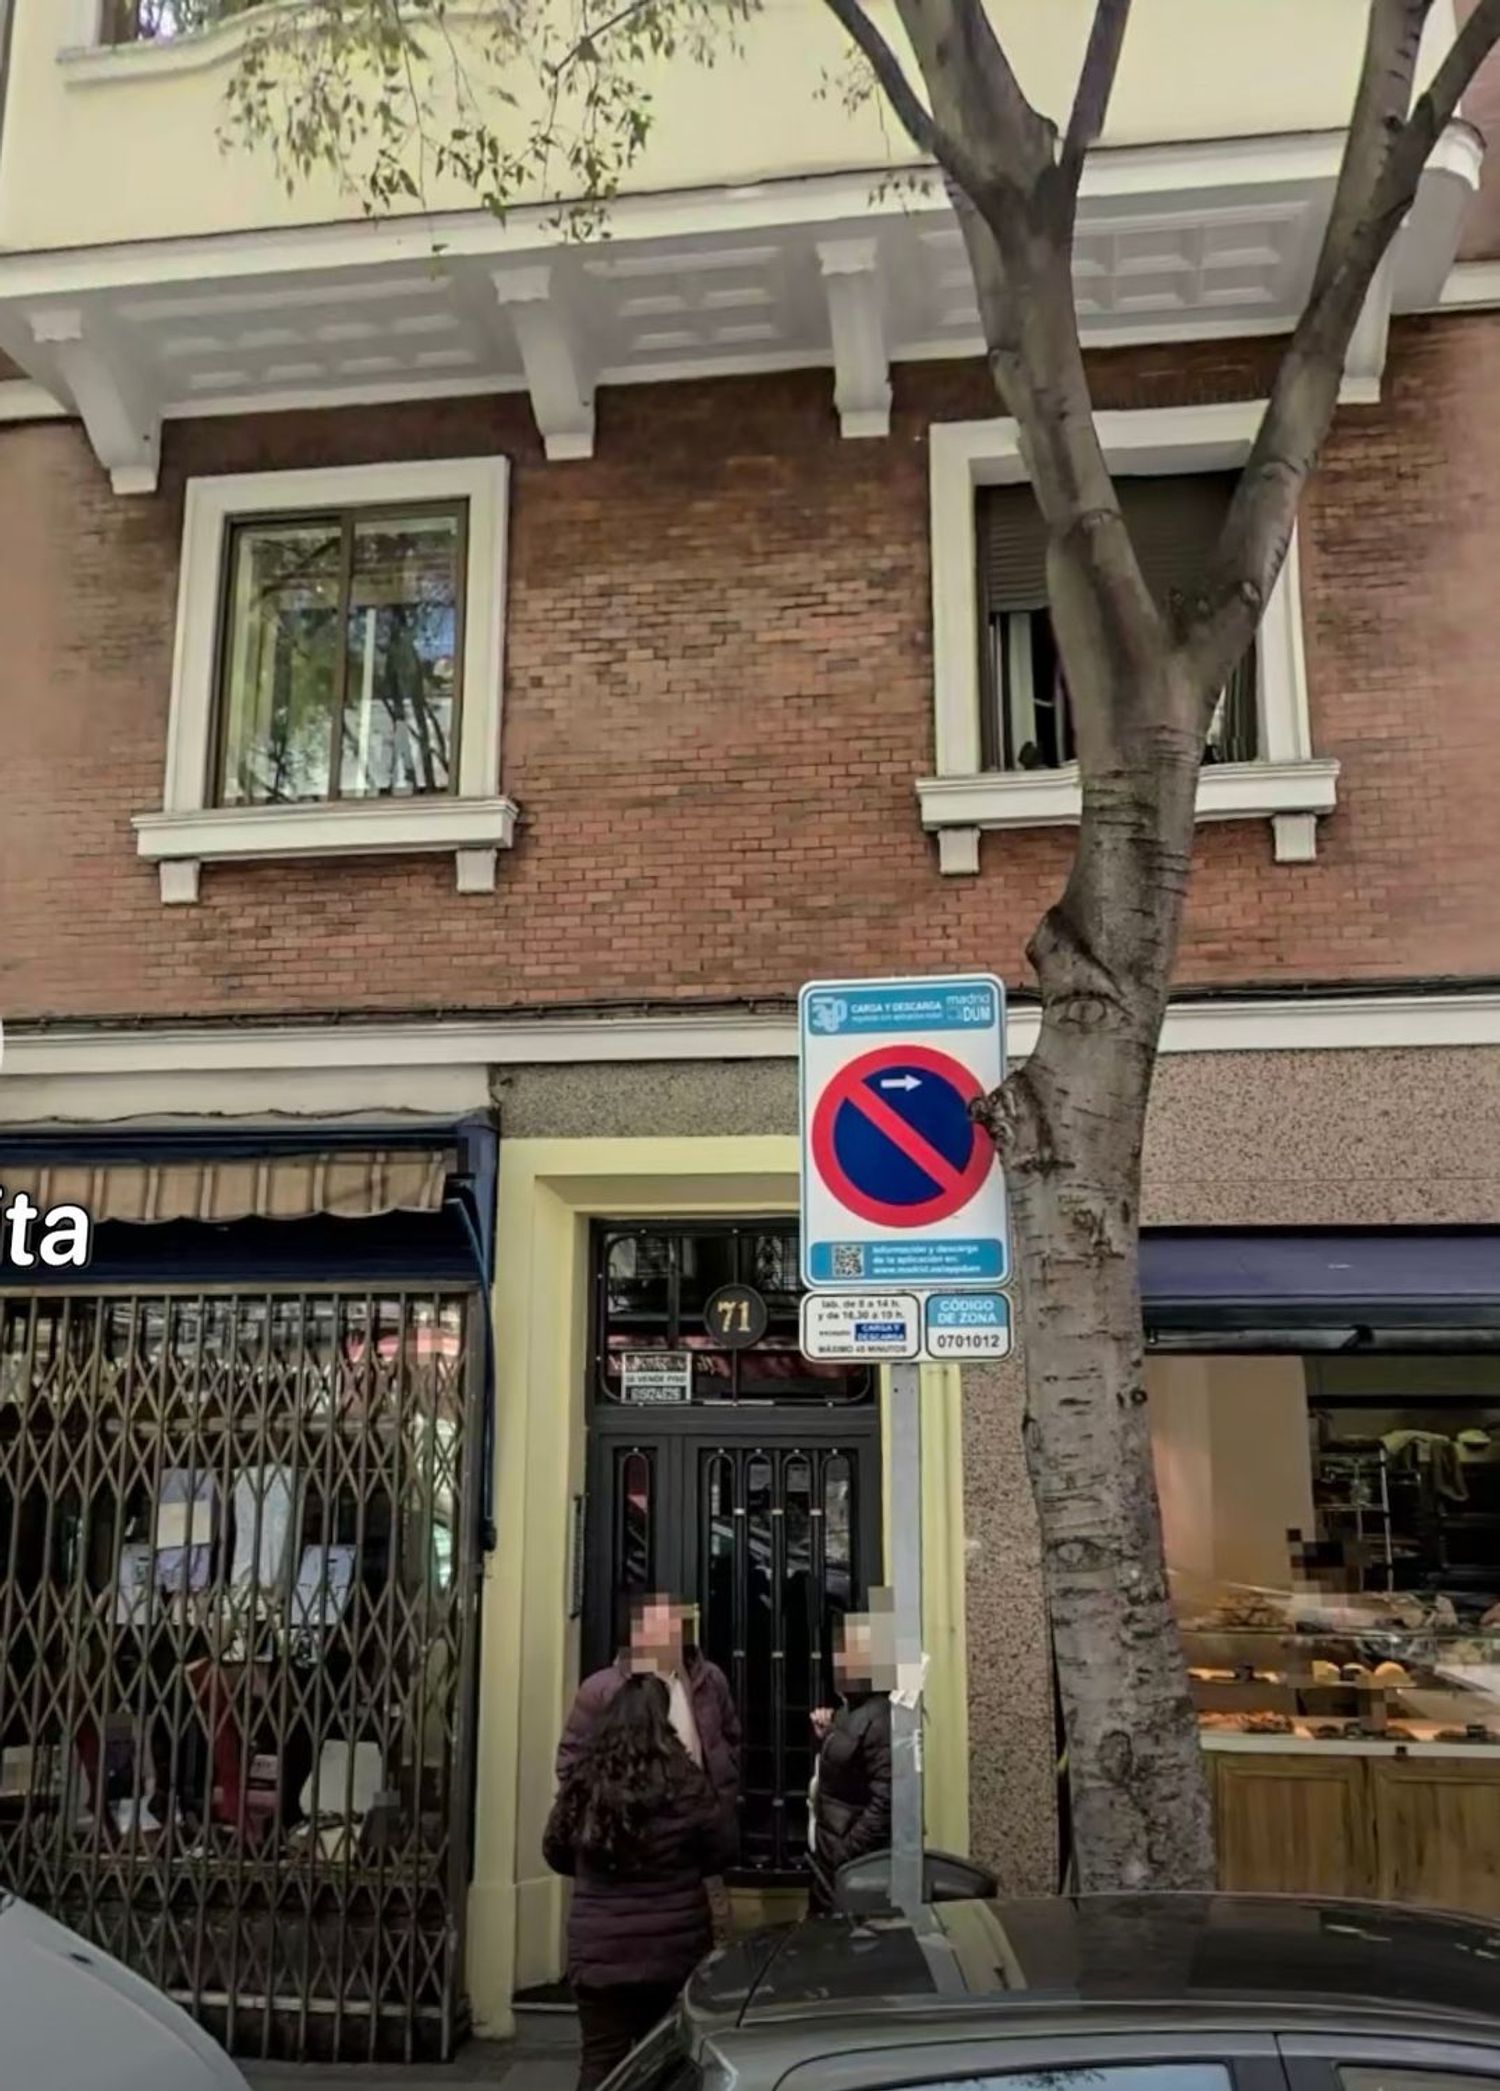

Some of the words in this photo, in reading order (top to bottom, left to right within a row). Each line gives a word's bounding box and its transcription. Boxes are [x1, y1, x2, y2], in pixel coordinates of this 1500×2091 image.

[946, 992, 991, 1006] madrid
[851, 1002, 883, 1014] CARGA
[885, 1002, 891, 1012] Y
[892, 1000, 942, 1012] DESCARGA
[962, 1006, 991, 1023] DUM
[843, 1300, 856, 1308] de
[940, 1298, 995, 1312] CÓDIGO
[717, 1301, 751, 1332] 71
[937, 1312, 956, 1324] DE
[959, 1312, 998, 1324] ZONA
[937, 1334, 1000, 1348] 0701012
